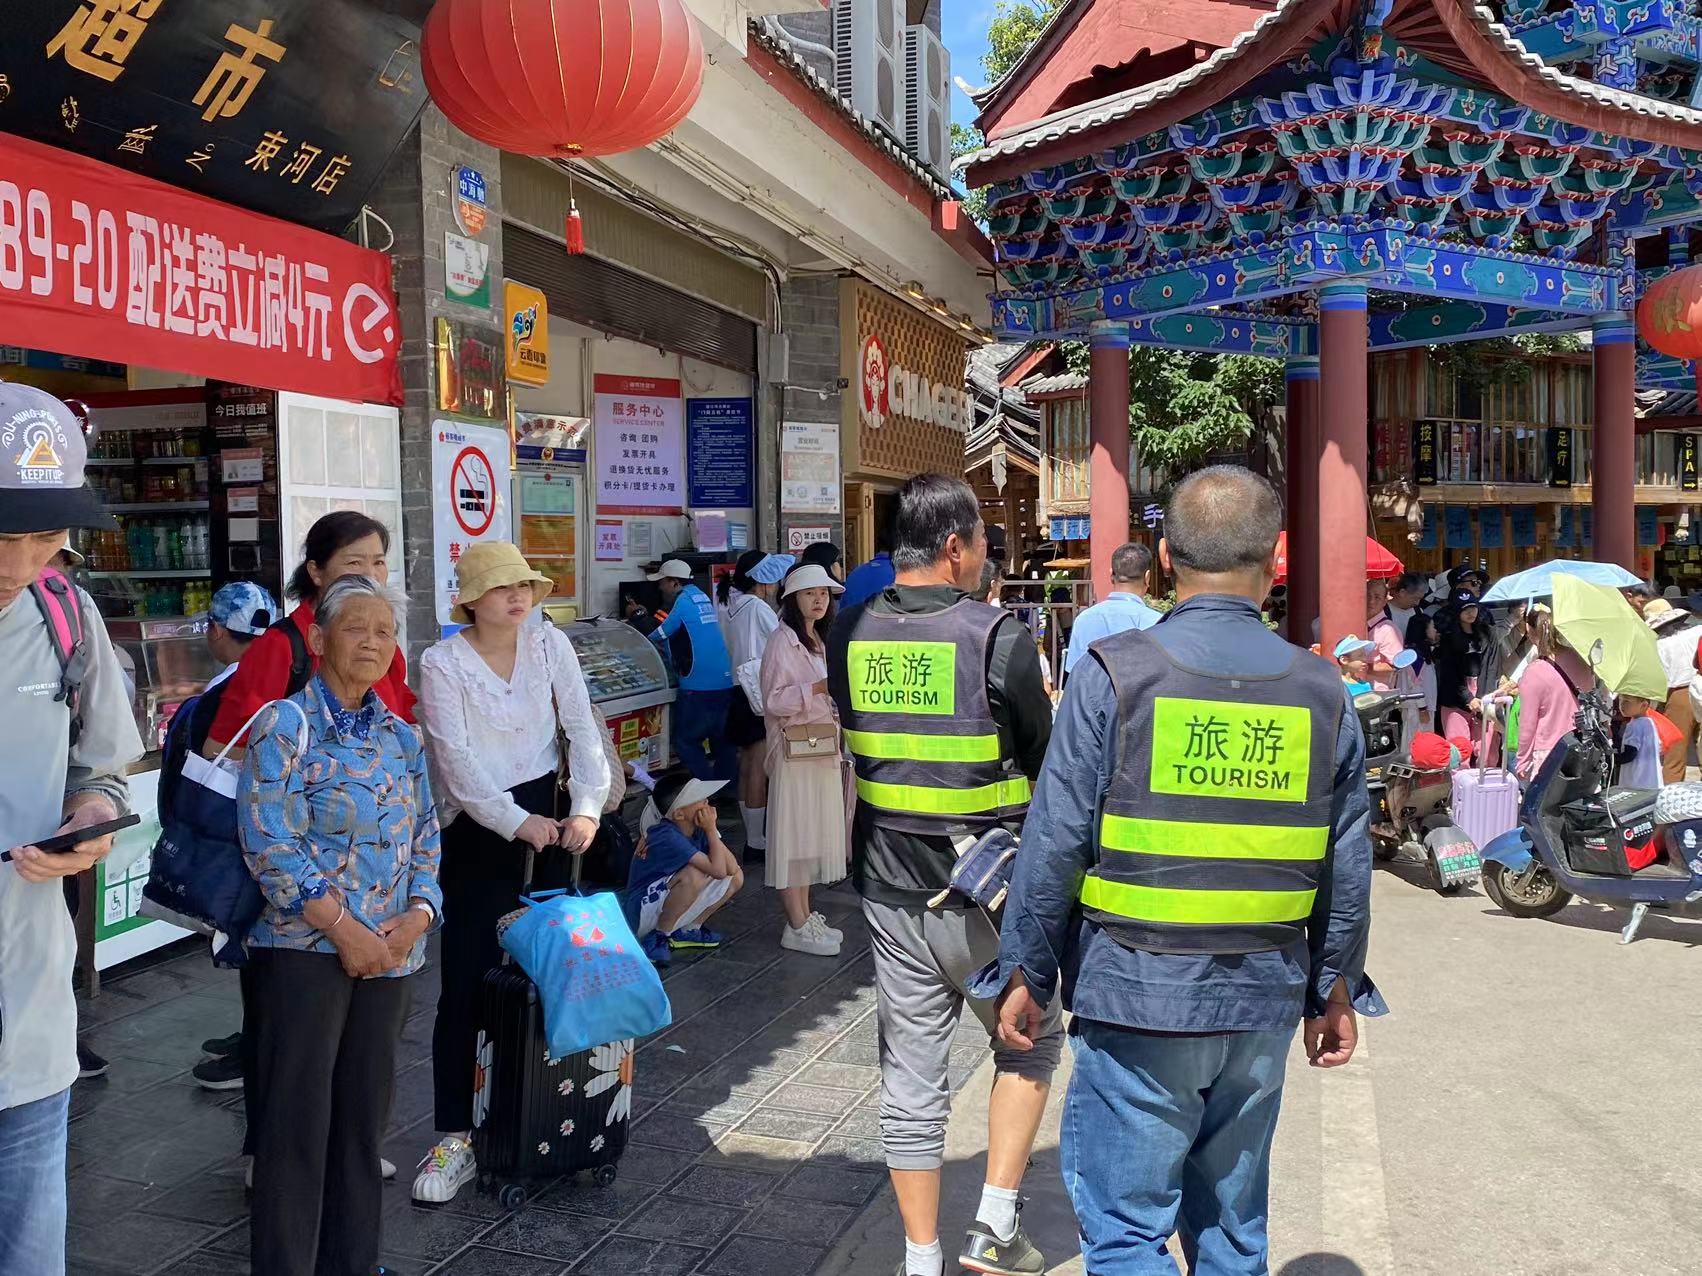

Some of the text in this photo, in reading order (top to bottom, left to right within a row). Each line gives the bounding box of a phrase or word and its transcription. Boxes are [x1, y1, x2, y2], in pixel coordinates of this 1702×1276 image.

[46, 0, 287, 123] 超市
[245, 130, 353, 196] 束河店
[126, 209, 333, 362] 配送费立减4元
[215, 403, 268, 416] 今日我值班
[612, 402, 664, 418] 服务中心
[620, 433, 658, 443] 咨询 团购
[622, 449, 657, 459] 发票开具
[1685, 436, 1695, 472] SPA
[609, 465, 669, 475] 退换货无忧服务
[604, 481, 675, 491] 积分卡/提货卡办理
[864, 651, 933, 687] 旅游
[859, 689, 939, 706] TOURISM
[1183, 714, 1285, 765] 旅游
[1172, 763, 1290, 790] TOURISM
